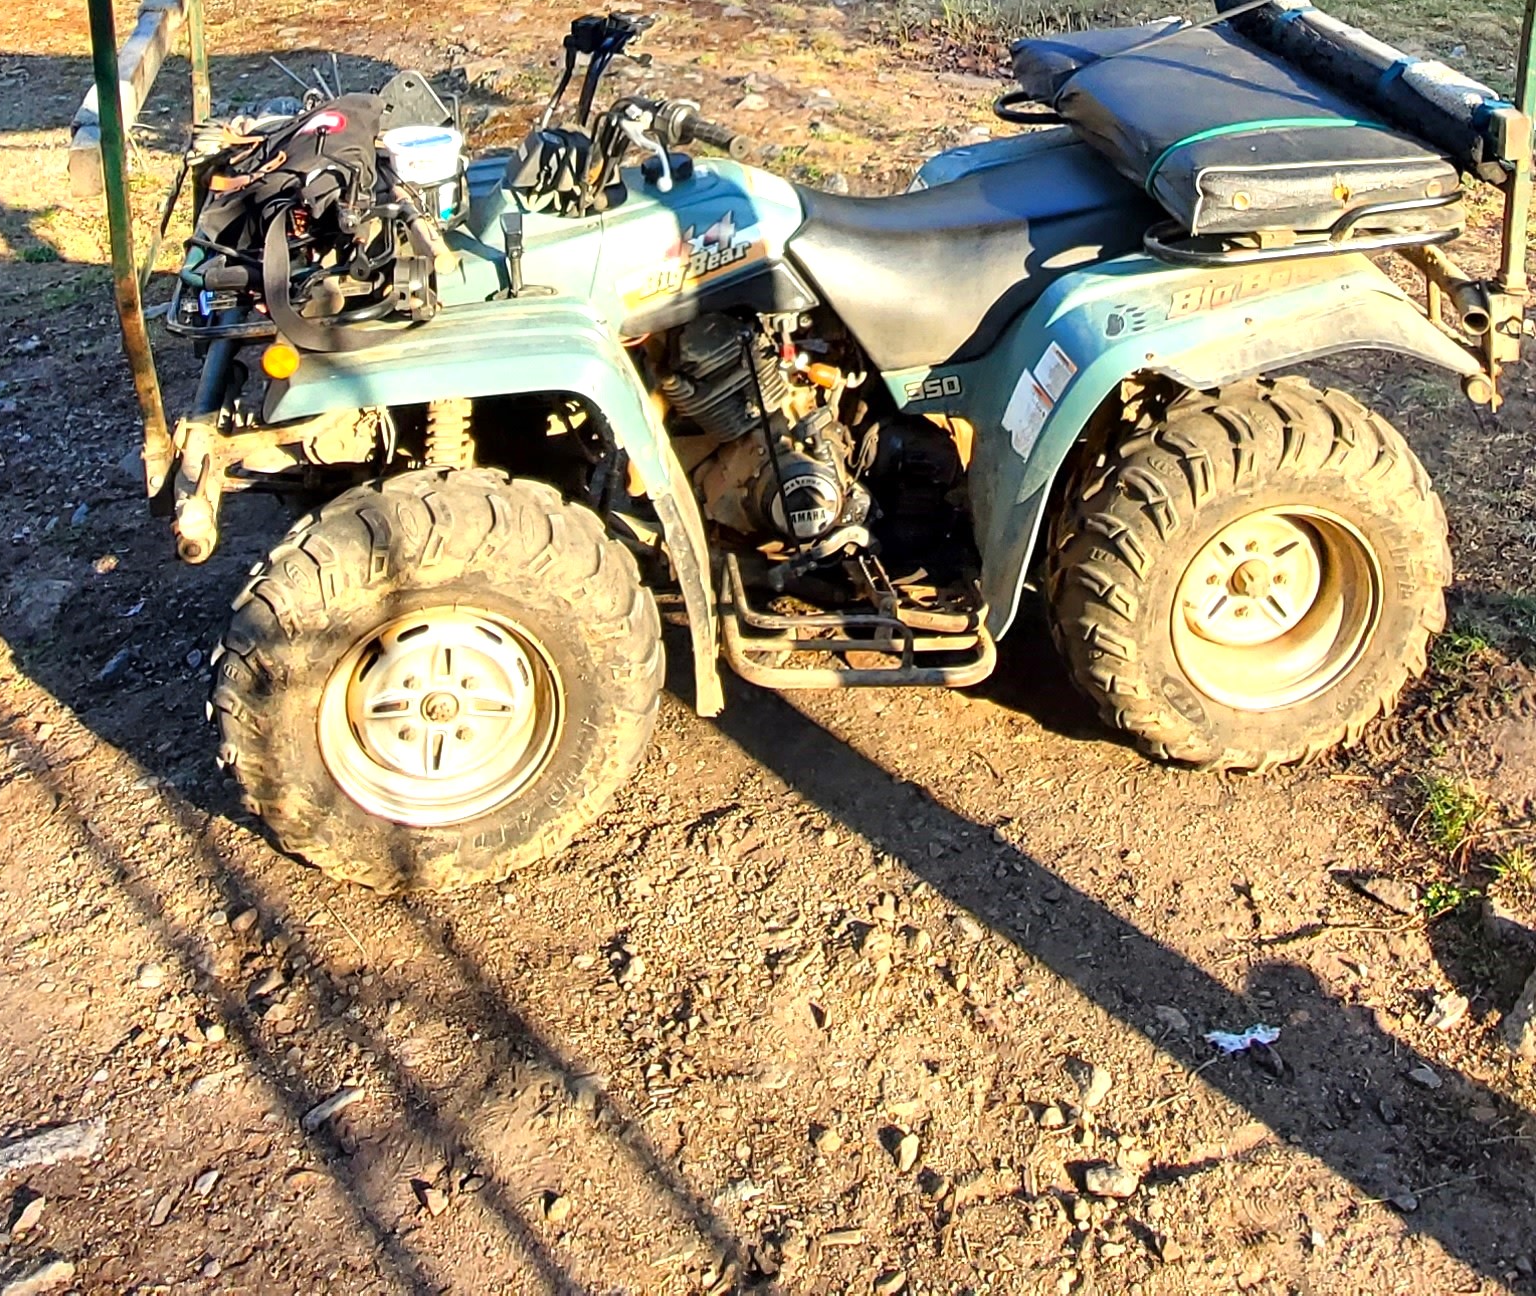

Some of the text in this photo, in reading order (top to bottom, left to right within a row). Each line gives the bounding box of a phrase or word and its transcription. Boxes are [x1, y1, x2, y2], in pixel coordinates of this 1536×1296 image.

[639, 241, 752, 300] Big Bear
[904, 375, 962, 402] 350
[789, 509, 826, 525] AMAHA
